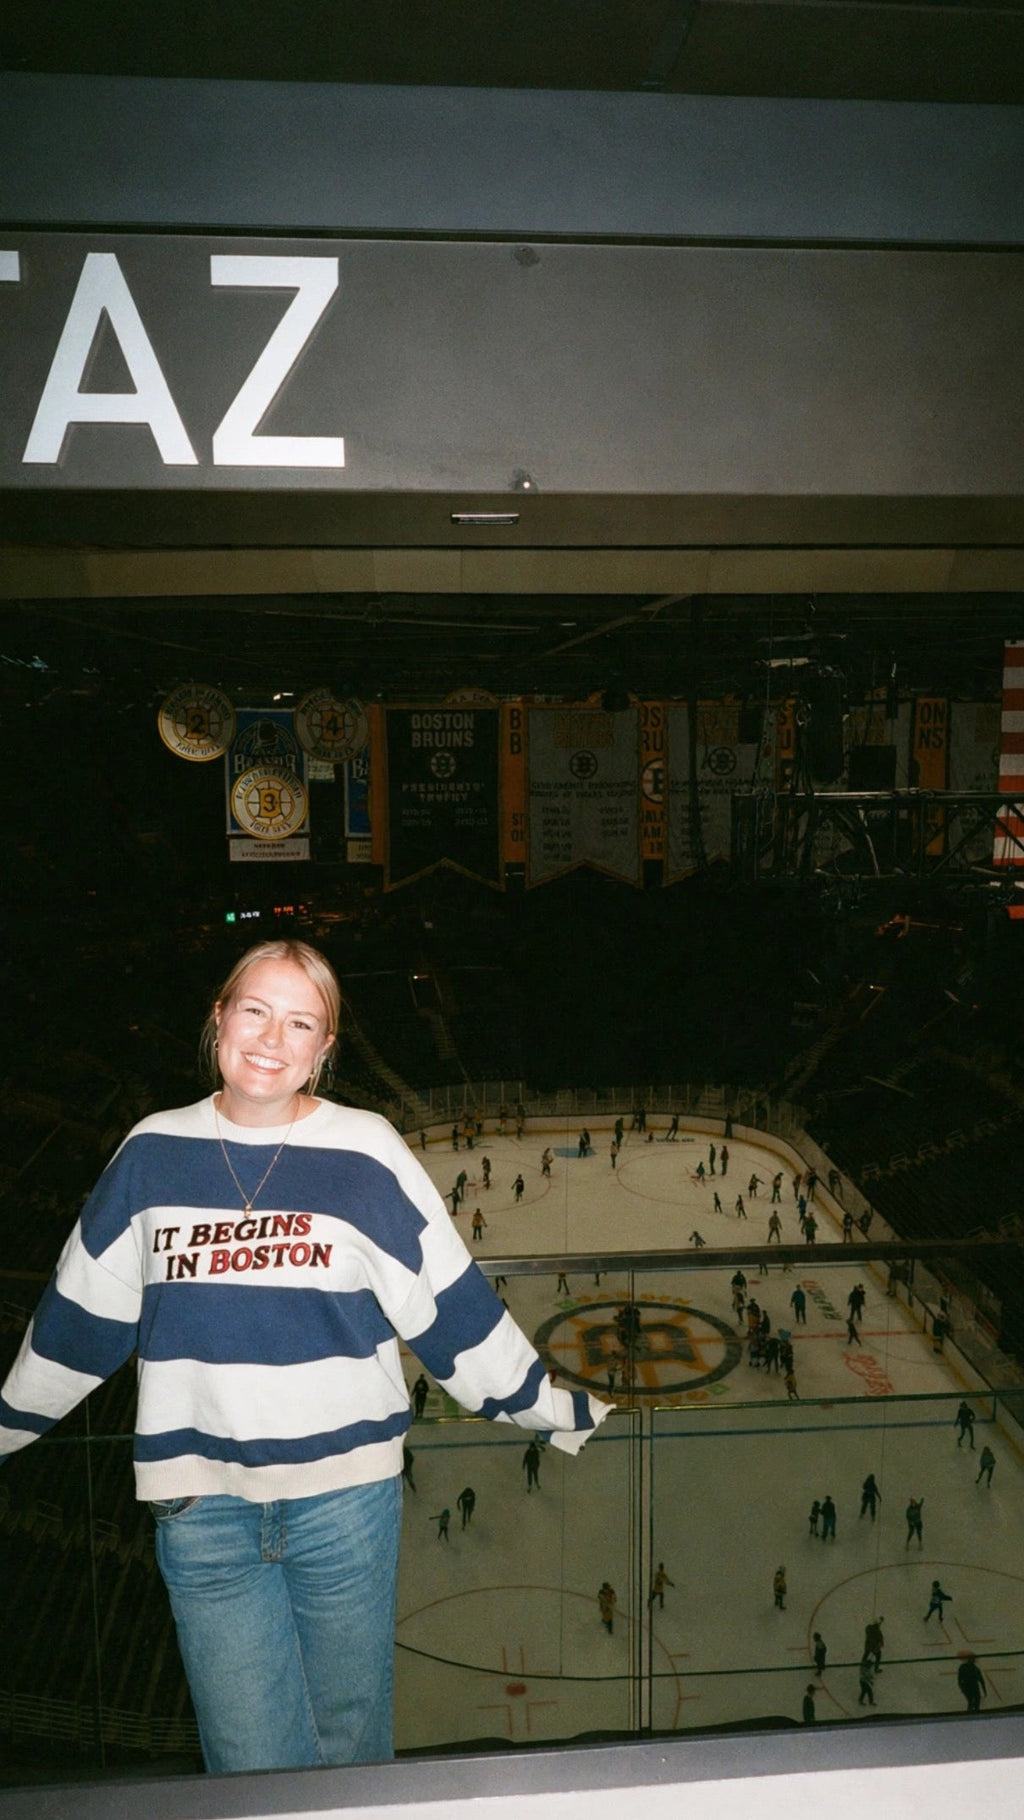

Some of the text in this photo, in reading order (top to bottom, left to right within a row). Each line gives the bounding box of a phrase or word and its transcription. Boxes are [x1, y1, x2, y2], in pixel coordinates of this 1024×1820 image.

[0, 250, 345, 467] AZ
[191, 713, 205, 734] 2
[411, 713, 475, 729] BOSTON
[411, 731, 475, 748] BRUINS
[263, 793, 276, 813] 3
[153, 1213, 312, 1253] IT BEGINS
[166, 1242, 333, 1281] IN BOSTON
